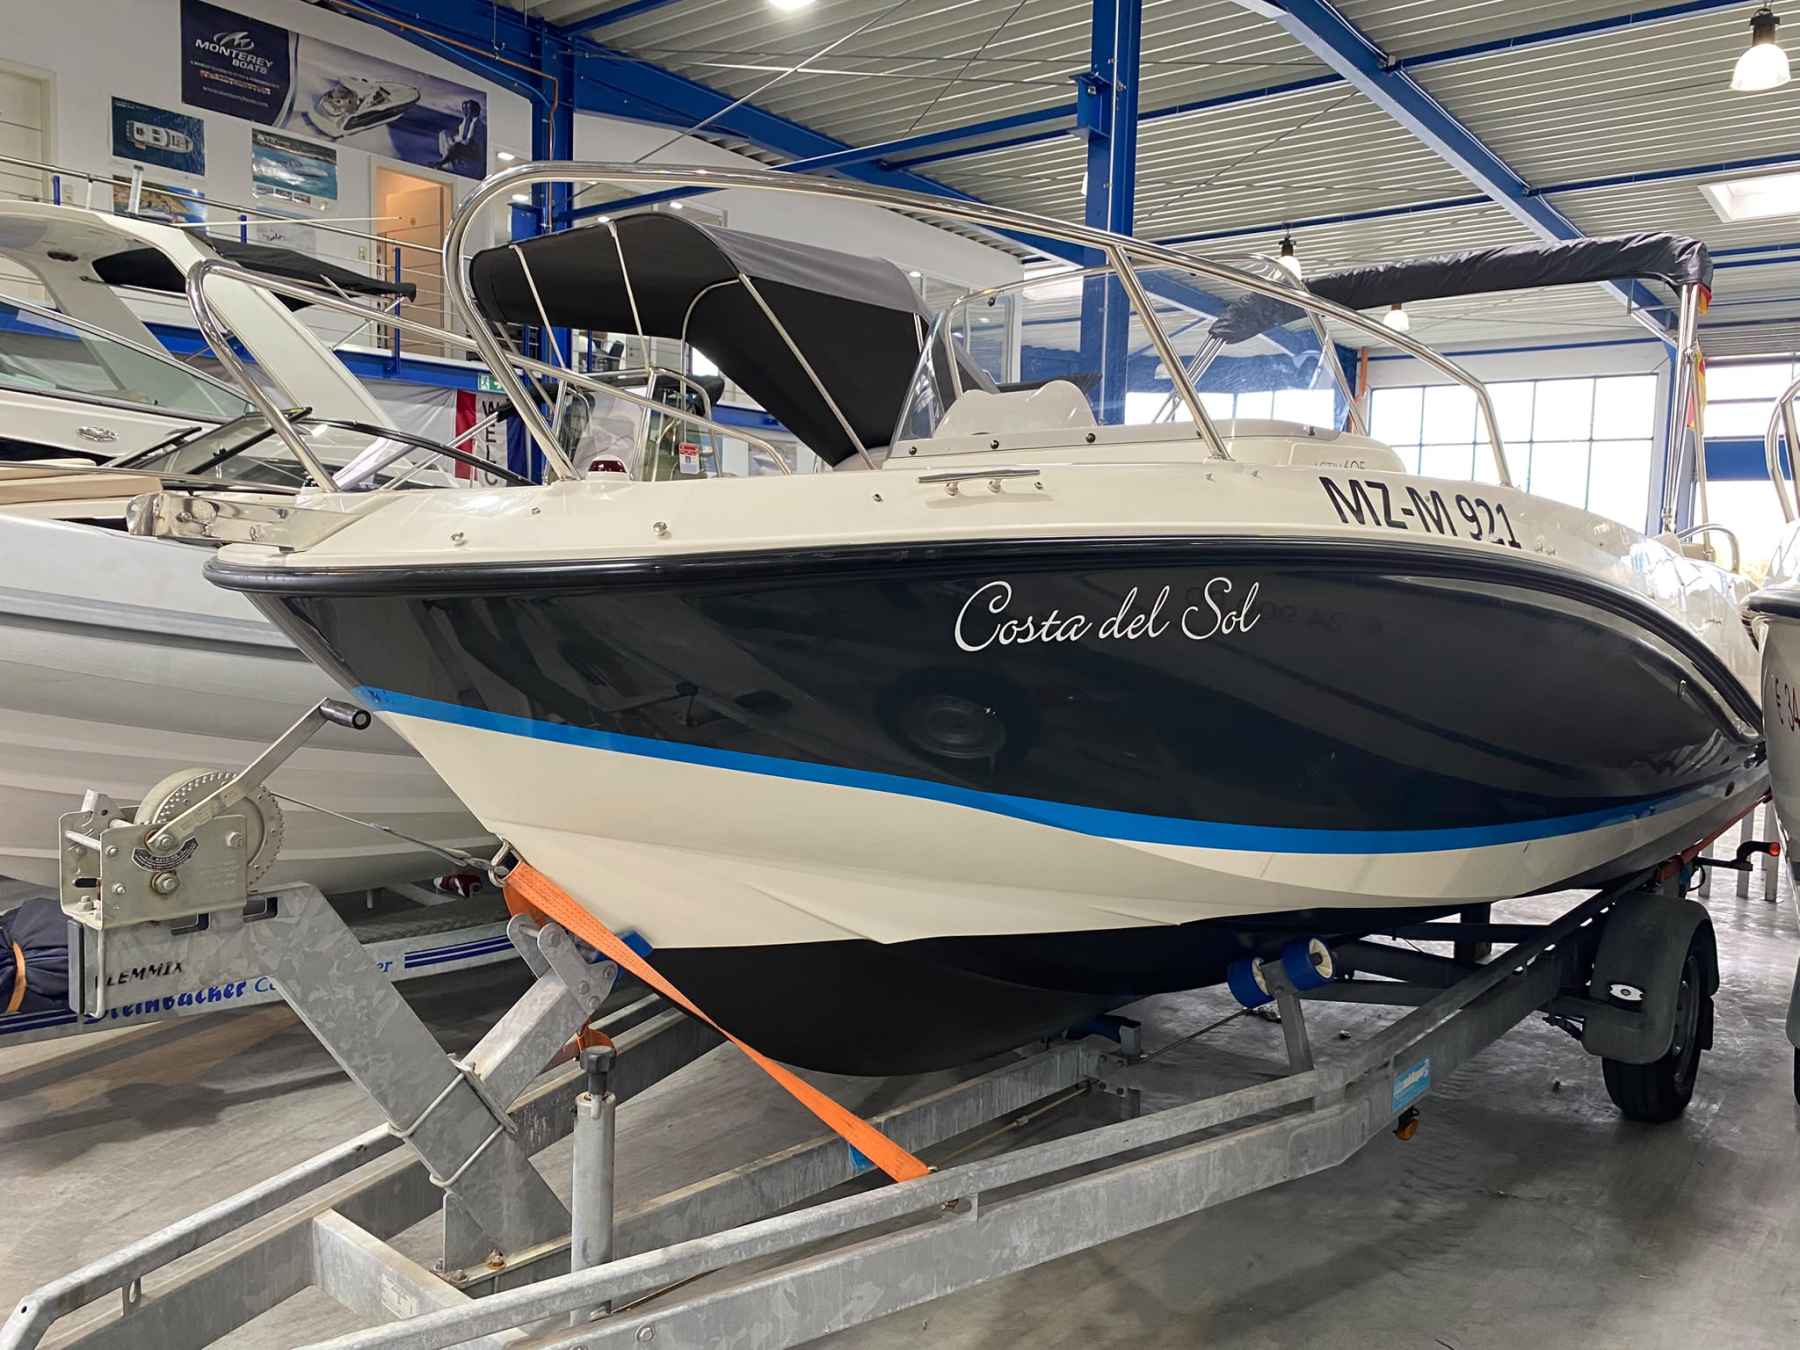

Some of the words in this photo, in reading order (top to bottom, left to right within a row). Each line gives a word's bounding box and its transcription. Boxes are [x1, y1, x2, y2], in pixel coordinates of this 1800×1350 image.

[195, 39, 273, 68] MONTEREY
[232, 59, 268, 74] BOATS
[1319, 476, 1458, 536] MZ-M
[1455, 494, 1522, 549] 921
[954, 580, 1093, 651] Costa
[1098, 585, 1170, 639] del
[1181, 577, 1261, 639] Sol
[95, 960, 183, 990] LEMMIX
